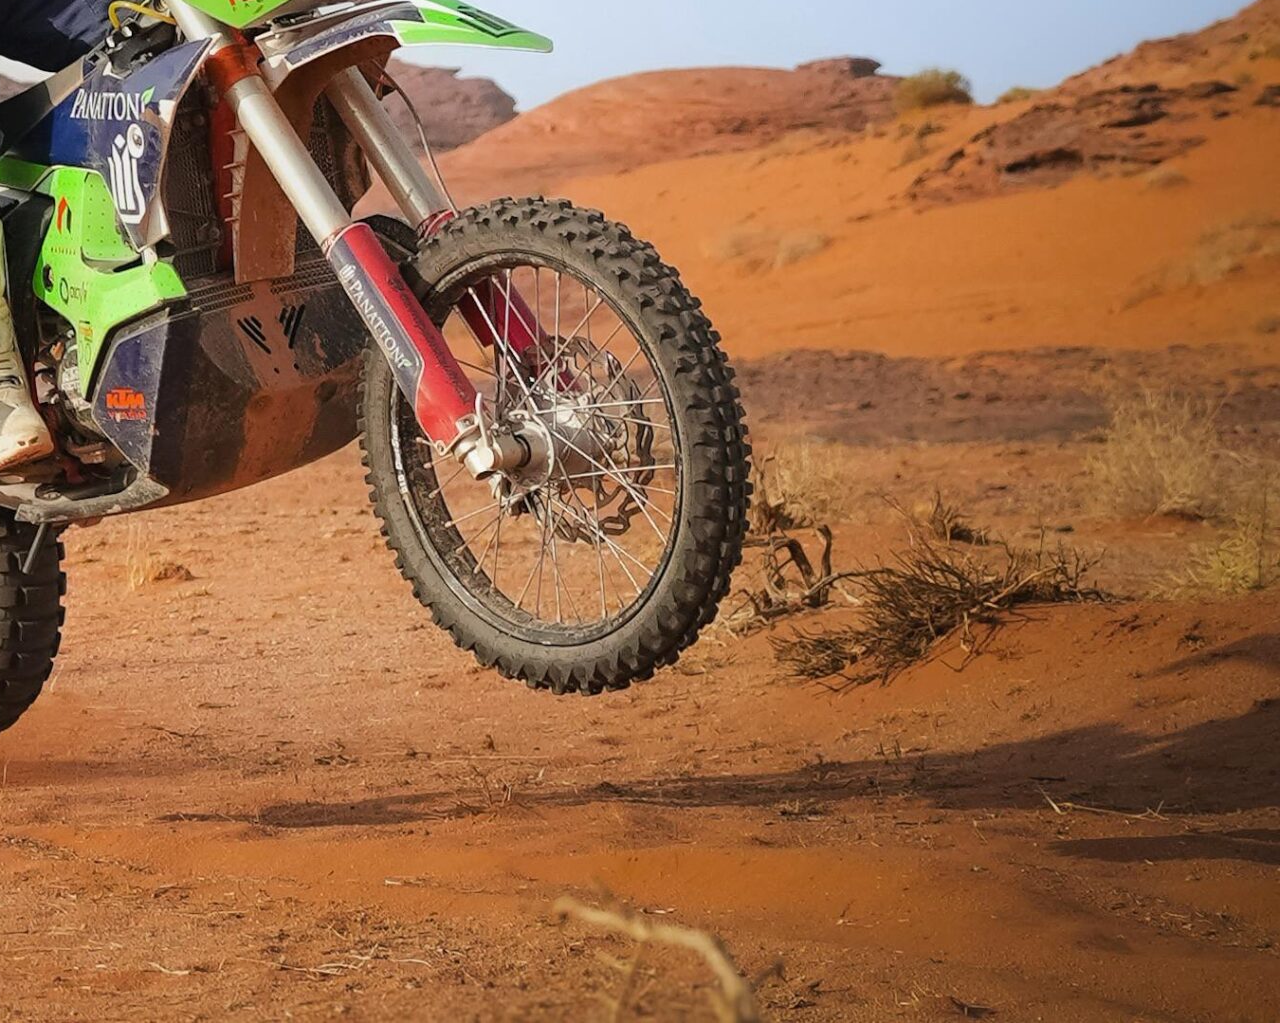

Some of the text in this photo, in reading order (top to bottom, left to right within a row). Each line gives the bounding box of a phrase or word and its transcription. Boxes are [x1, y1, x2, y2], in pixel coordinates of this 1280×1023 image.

[69, 82, 156, 121] PANATTONI
[349, 278, 413, 370] PANATTONI
[106, 388, 145, 409] KTM
